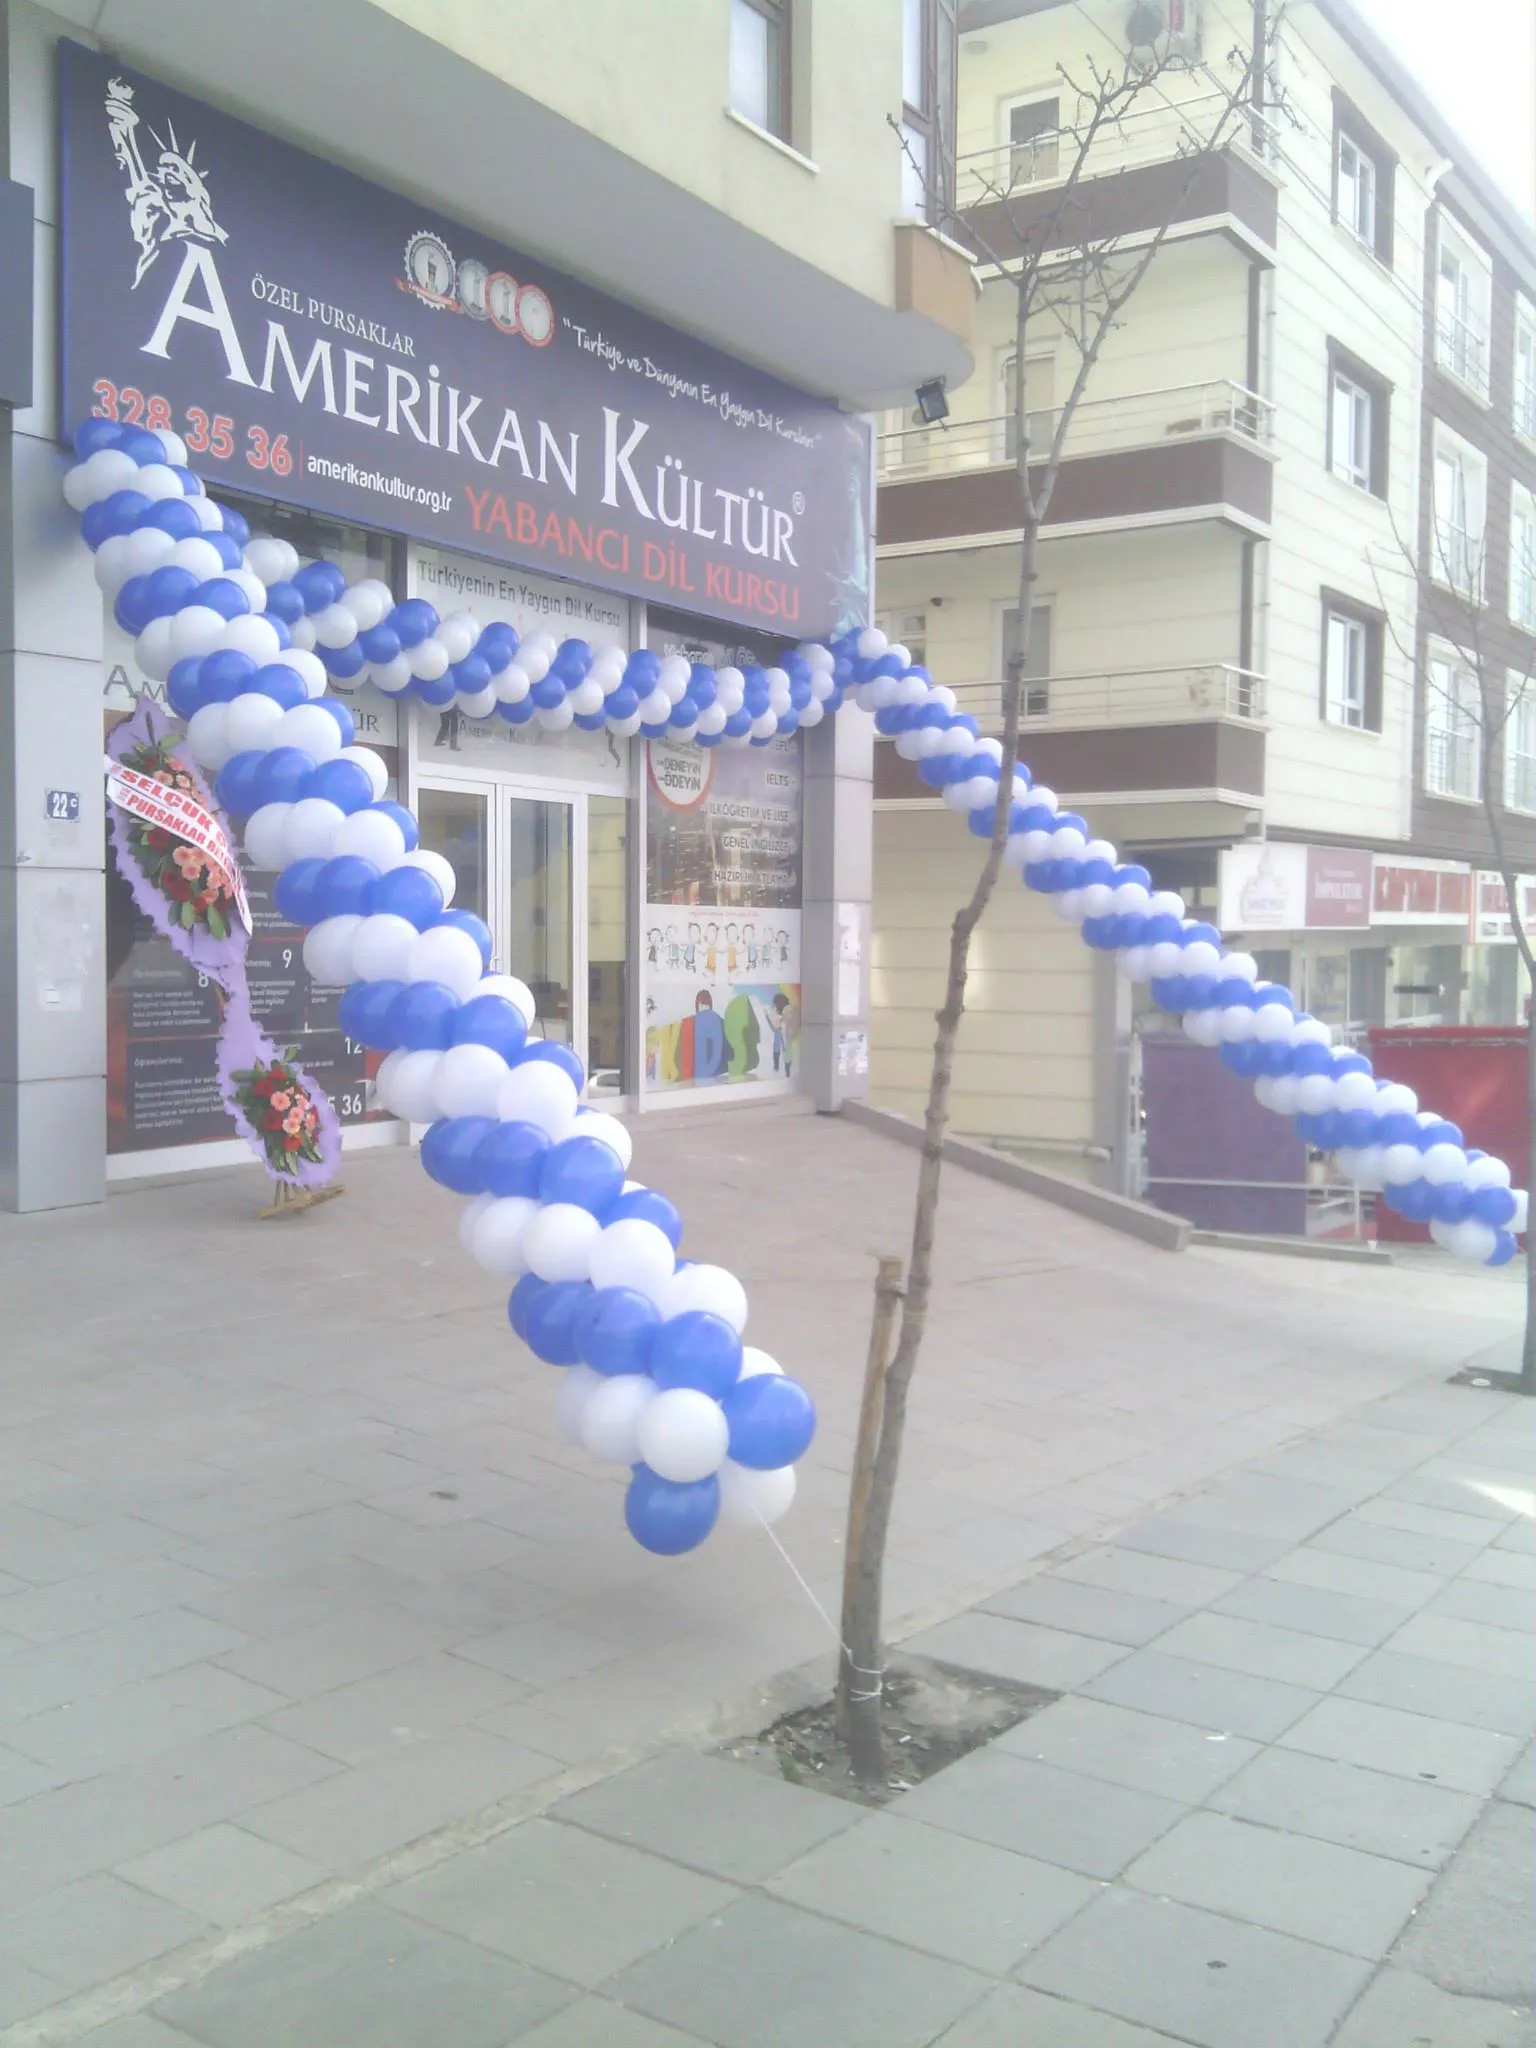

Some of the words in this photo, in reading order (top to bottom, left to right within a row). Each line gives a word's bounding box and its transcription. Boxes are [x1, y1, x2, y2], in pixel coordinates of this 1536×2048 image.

[250, 273, 304, 315] ÖZEL
[307, 302, 416, 358] PURSAKLAR
[139, 240, 580, 496] AMERİKAN
[601, 406, 800, 568] KÜLTÜR
[627, 358, 642, 372] ve
[701, 384, 717, 408] En
[92, 379, 172, 432] 328
[185, 406, 234, 459] 35
[247, 425, 293, 476] 36
[308, 455, 453, 514] amerikankultur.org.tr
[463, 485, 629, 574] YABANCI
[643, 538, 695, 593] DİL
[705, 560, 800, 622] KURSU
[417, 560, 496, 598] Türkiyenin
[500, 579, 516, 602] En
[520, 584, 561, 615] Yaygın
[565, 596, 582, 618] Dil
[585, 603, 621, 627] Kursu
[52, 792, 69, 817] 22
[282, 948, 292, 969] 9
[341, 1094, 362, 1116] 36
